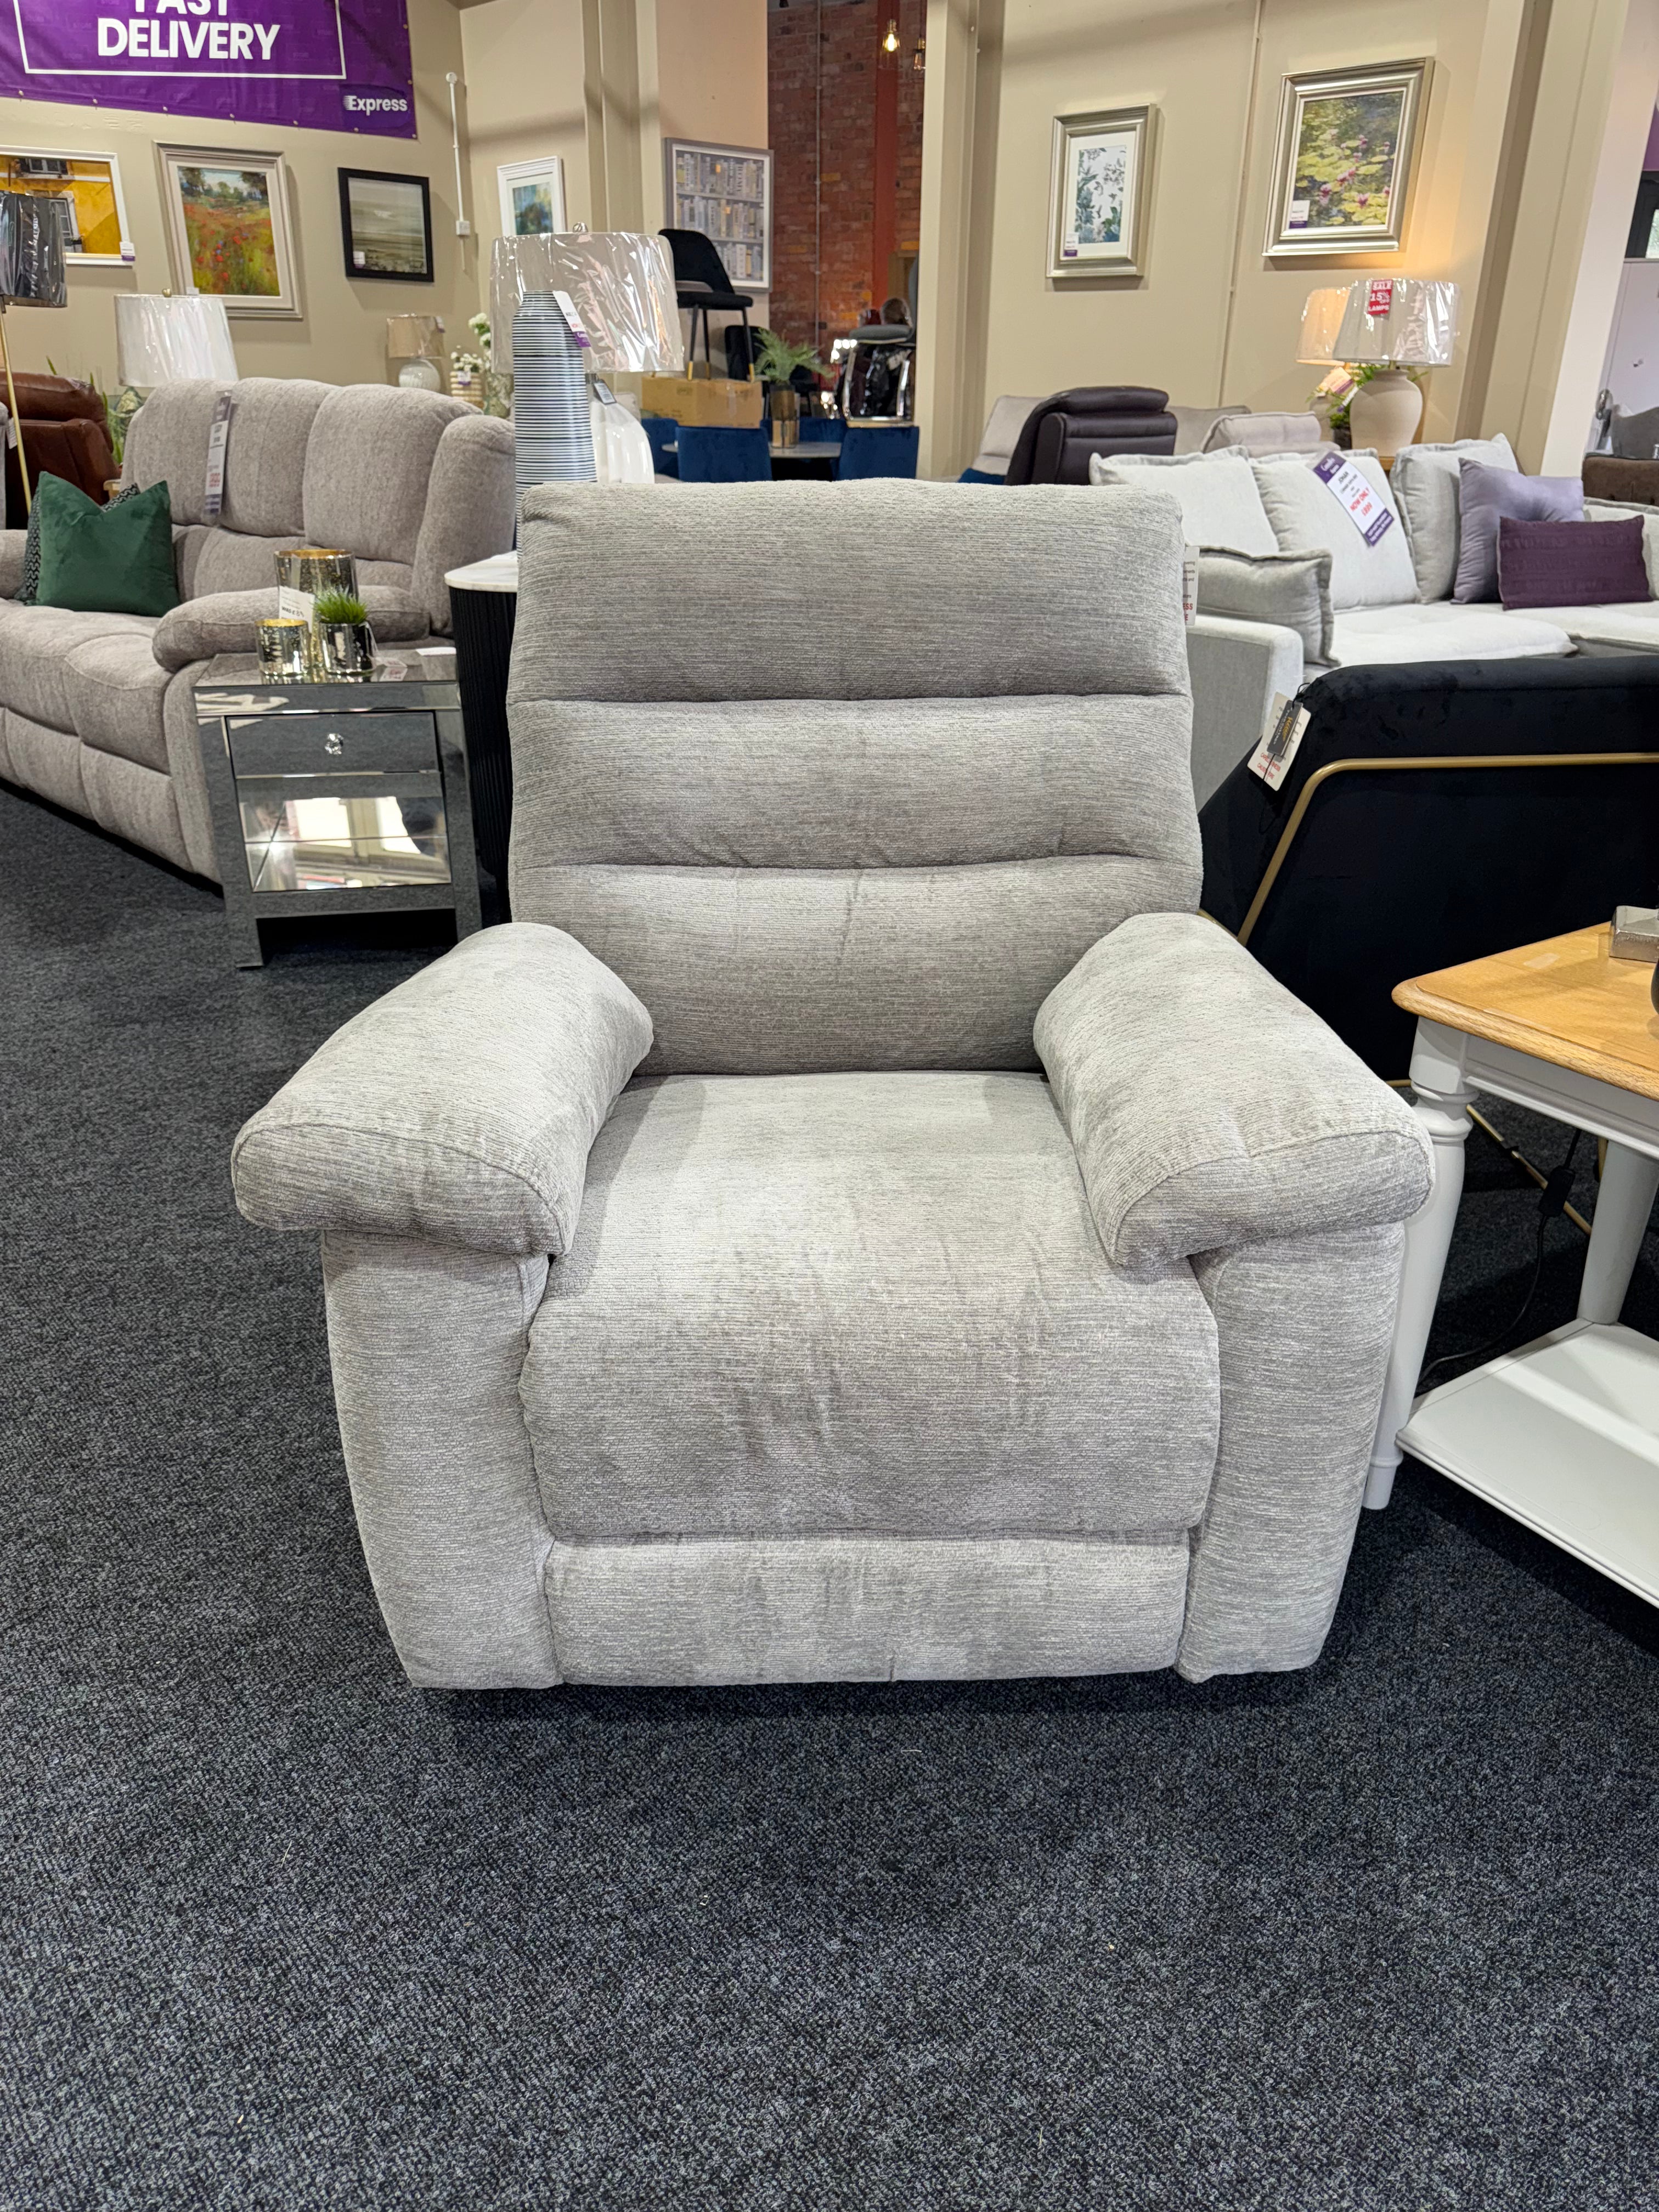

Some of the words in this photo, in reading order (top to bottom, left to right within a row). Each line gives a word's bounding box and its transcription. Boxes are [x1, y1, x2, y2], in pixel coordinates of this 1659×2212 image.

[98, 18, 281, 60] DELIVERY
[343, 95, 408, 116] Express
[1372, 280, 1392, 290] SALE
[1350, 498, 1361, 511] NOW
[1358, 487, 1370, 501] ONLY
